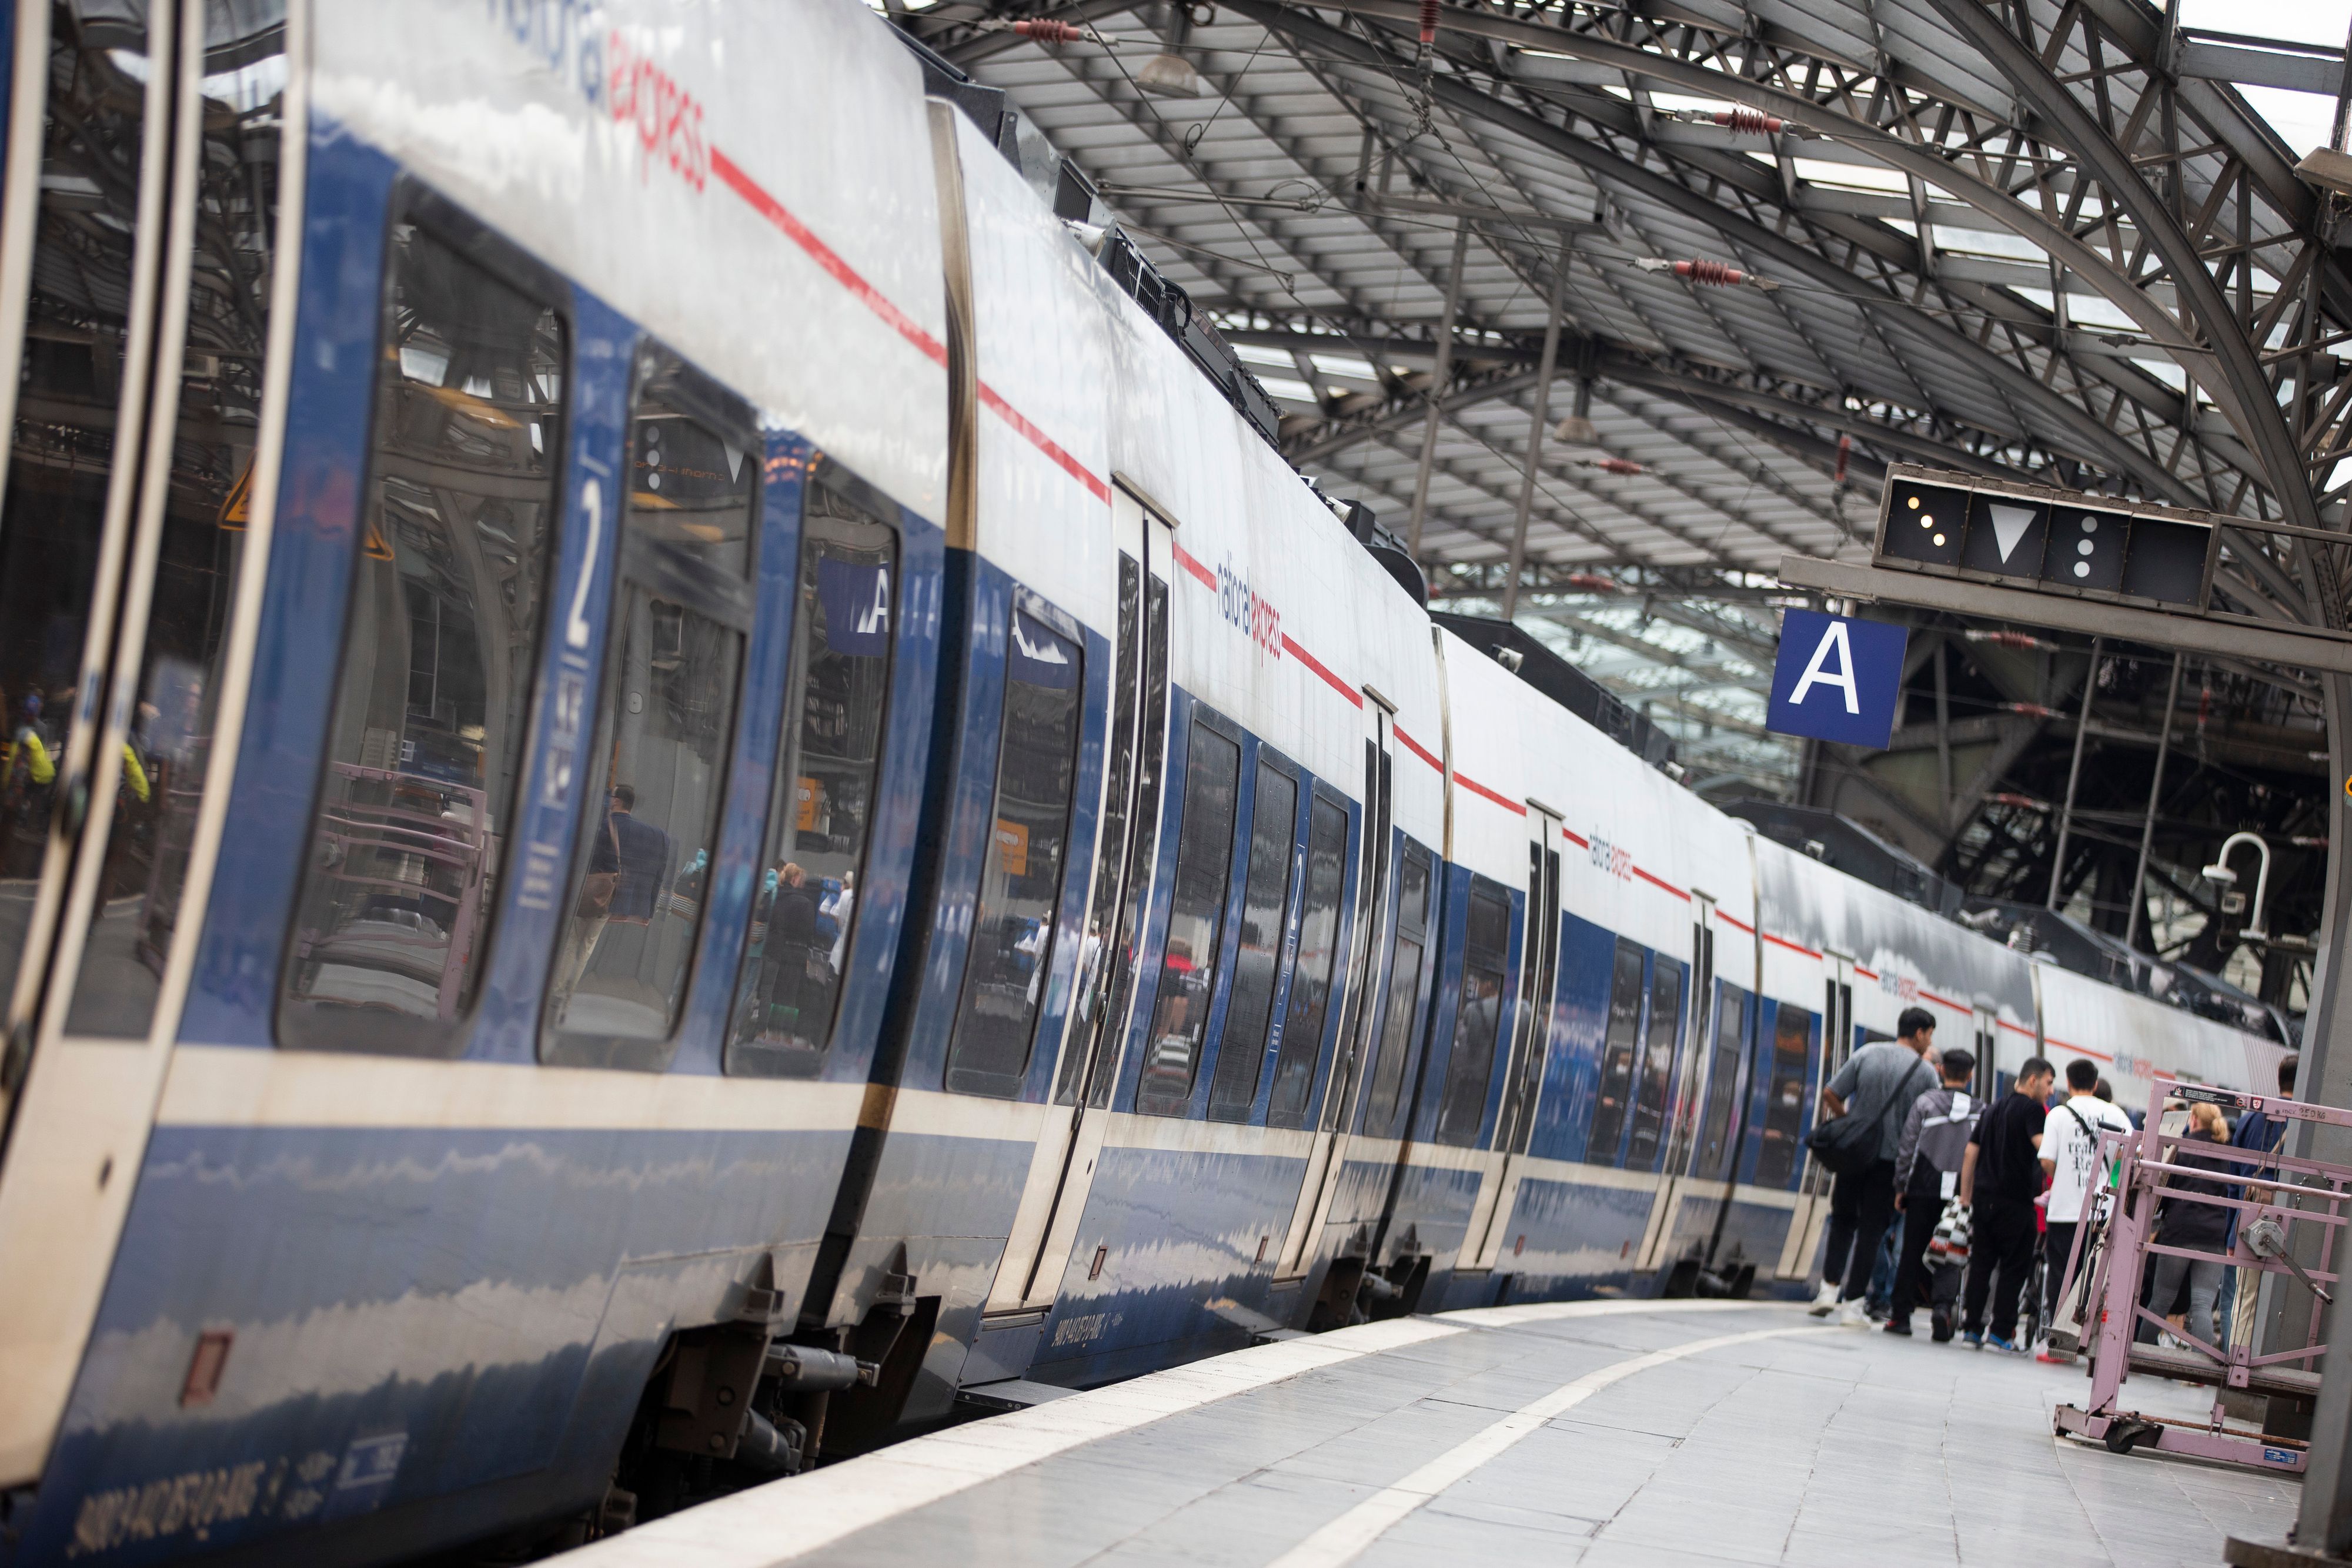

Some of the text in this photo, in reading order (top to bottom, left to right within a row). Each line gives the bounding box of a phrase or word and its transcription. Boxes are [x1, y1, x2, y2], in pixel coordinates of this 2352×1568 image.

[1217, 550, 1281, 667] national express
[1788, 621, 1859, 714] A
[1291, 853, 1302, 931] 2
